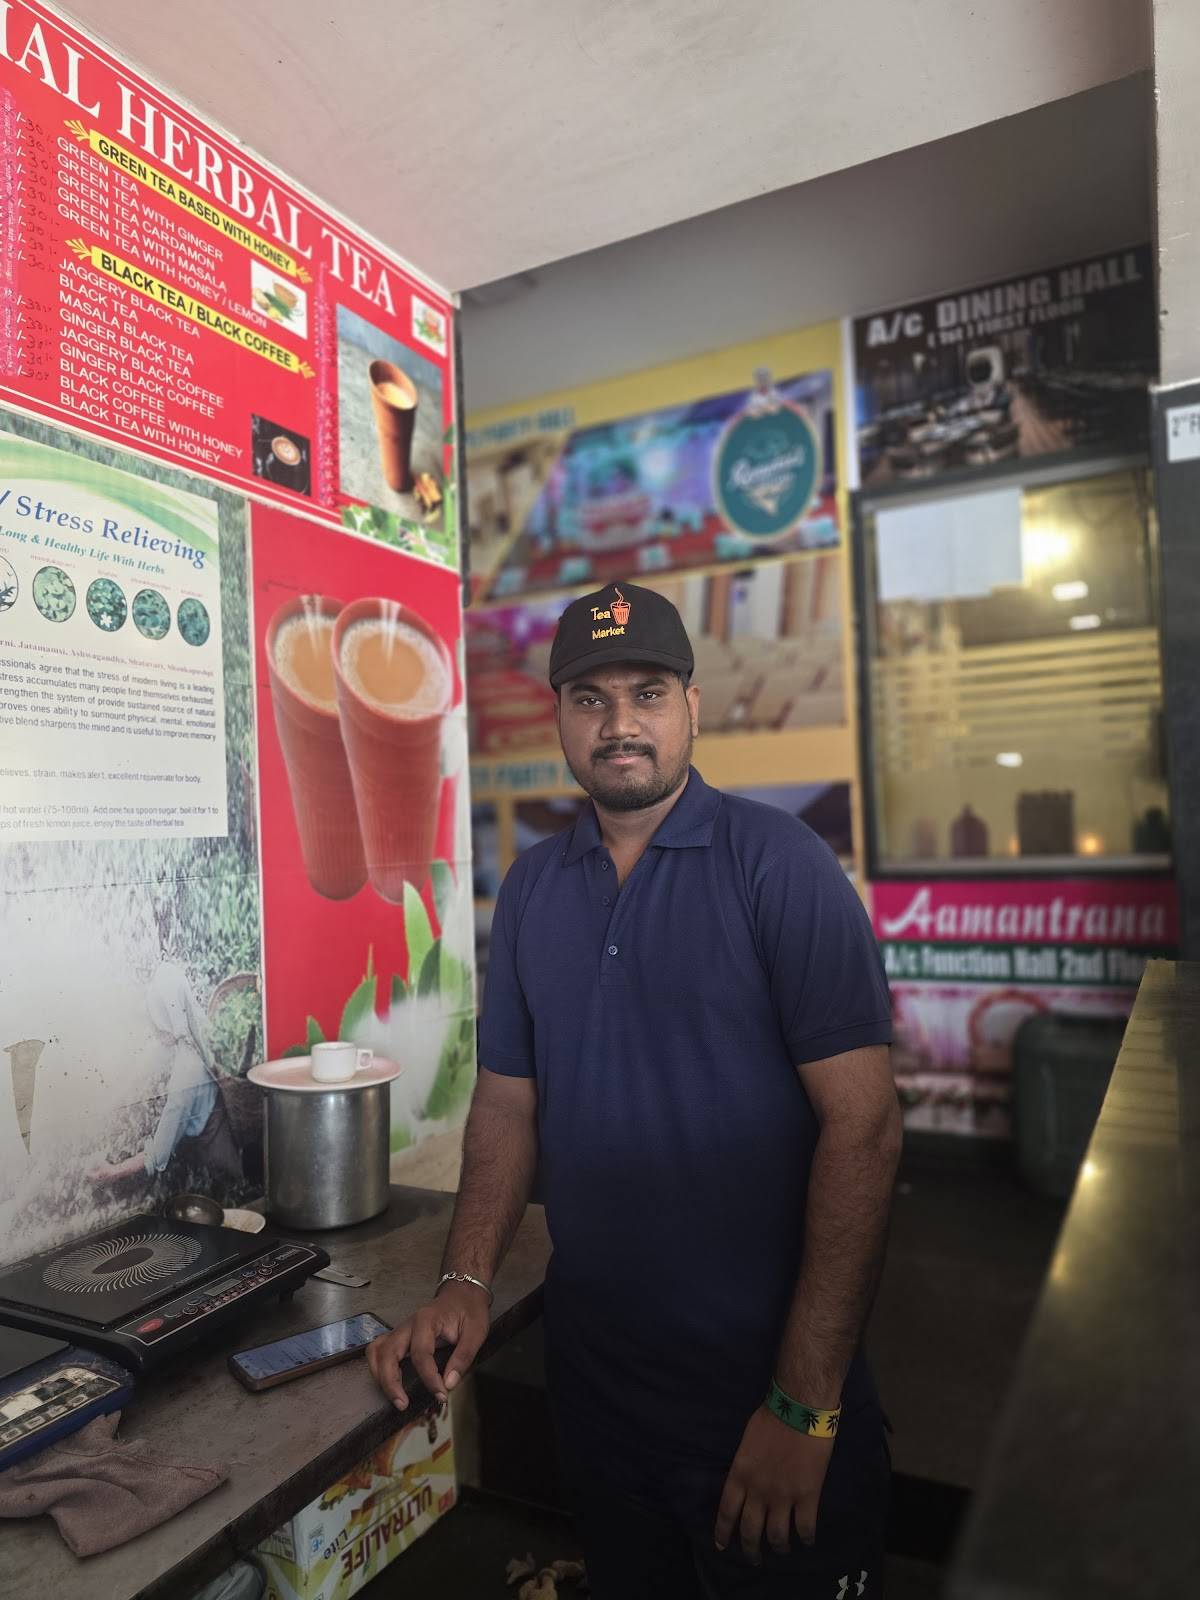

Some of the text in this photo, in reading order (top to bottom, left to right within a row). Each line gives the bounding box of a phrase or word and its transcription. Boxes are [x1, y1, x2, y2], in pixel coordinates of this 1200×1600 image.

[57, 137, 140, 196] GREEN TEA
[116, 82, 312, 260] HERBAL
[322, 228, 397, 316] TEA
[57, 154, 223, 262] GREEN TEA WITH GINGER
[57, 170, 216, 271] GREEN TEA CARDAMON
[57, 187, 227, 293] GREEN TEA WITH MASALA
[98, 139, 291, 270] GREEN TEA BASED WITH HONEY
[57, 204, 110, 241] GREEN
[113, 234, 141, 258] TEA
[142, 251, 176, 278] WITH
[179, 271, 220, 301] HONEY
[228, 300, 267, 328] LEMON
[59, 258, 201, 338] JAGGERY BLACK TEA
[60, 273, 138, 322] BLACK TEA
[866, 253, 1142, 346] A/c DINING HALL
[60, 291, 195, 365] MASALA BLACK TEA
[60, 308, 191, 378] GINGER BLACK TEA
[101, 253, 154, 294] BLACK
[157, 284, 187, 313] TEA
[197, 306, 242, 341] BLACK
[244, 333, 292, 368] COFFEE
[59, 326, 224, 408] JAGGERY BLACK COFFEE
[60, 341, 215, 419] GINGER BLACK COFFEE
[60, 358, 165, 410] BLACK COFFEE
[60, 375, 243, 458] BLACK COFFEE WITH HONEY
[60, 392, 220, 463] BLACK TEA WITH HONEY
[16, 495, 94, 533] Stress
[101, 518, 206, 569] Relieving
[30, 533, 41, 545] &
[44, 537, 86, 557] Healthy
[89, 547, 110, 561] Life
[112, 553, 135, 568] With
[137, 560, 165, 574] Herbs
[590, 606, 611, 621] Tea
[591, 625, 626, 640] Market
[26, 676, 77, 689] accumulates
[79, 683, 100, 694] many
[102, 686, 126, 696] people
[128, 687, 142, 697] find
[39, 664, 63, 674] agree
[65, 666, 80, 677] that
[82, 668, 95, 678] the
[97, 671, 120, 681] stress
[131, 676, 158, 686] modern
[41, 691, 54, 700] the
[57, 694, 85, 704] system
[98, 698, 125, 708] provide
[128, 701, 160, 711] sustained
[162, 705, 185, 714] source
[16, 716, 39, 727] blend
[40, 718, 77, 730] sharpens
[79, 721, 91, 731] the
[92, 723, 110, 733] mind
[111, 725, 125, 733] and
[133, 727, 155, 736] useful
[191, 732, 216, 742] memory
[30, 704, 51, 714] ones
[53, 705, 79, 717] ability
[91, 710, 126, 721] surmount
[108, 771, 139, 781] excellent
[881, 886, 1166, 938] Aamantrana
[323, 1528, 348, 1559] Lite
[341, 1485, 432, 1580] ULTRALIFE
